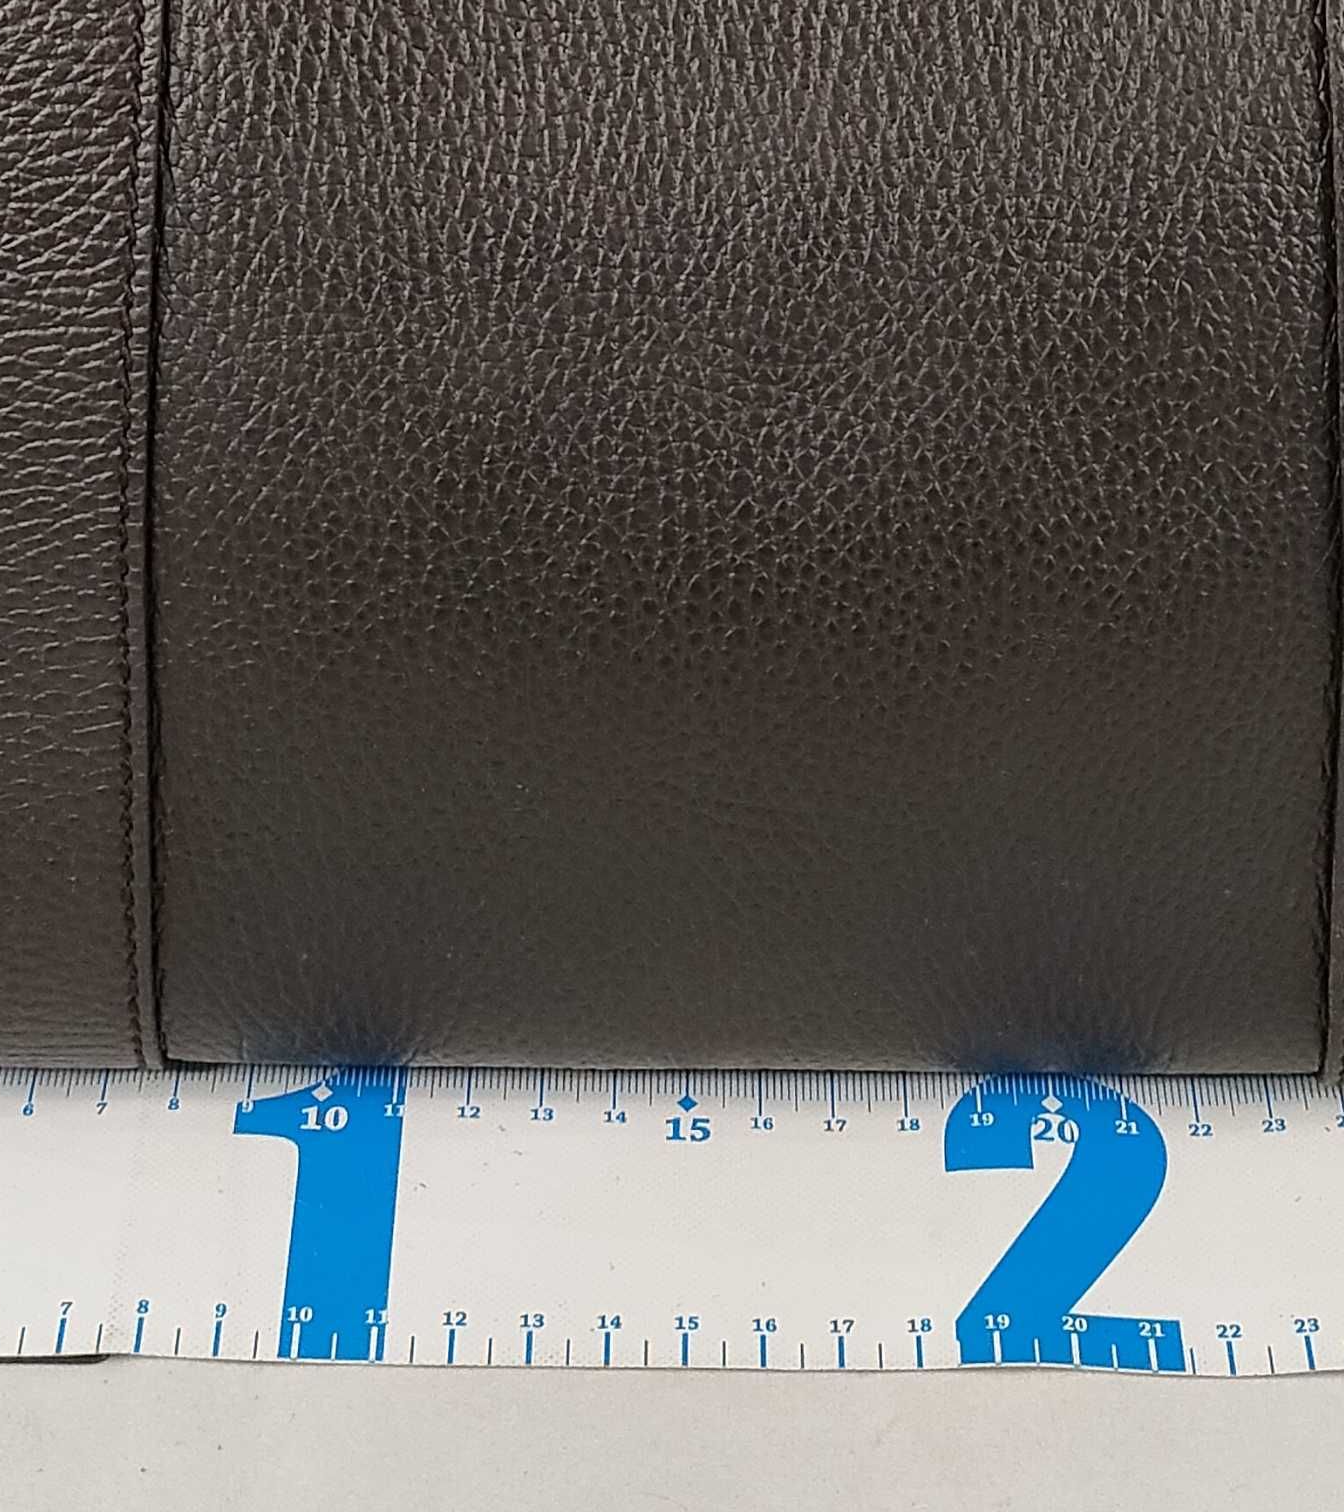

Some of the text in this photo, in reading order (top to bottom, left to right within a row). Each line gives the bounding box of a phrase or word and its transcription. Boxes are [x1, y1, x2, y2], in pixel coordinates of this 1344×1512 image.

[22, 1104, 34, 1116] 6
[95, 1102, 108, 1115] 7
[167, 1097, 180, 1110] 8
[241, 1100, 254, 1113] 9
[299, 1105, 349, 1131] 10
[384, 1104, 406, 1117] 11
[456, 1106, 481, 1119] 12
[530, 1108, 554, 1121] 13
[603, 1111, 626, 1124] 14
[665, 1117, 712, 1143] 15
[750, 1116, 774, 1130] 16
[823, 1118, 848, 1132] 17
[896, 1118, 921, 1131] 18
[969, 1112, 995, 1127] 19
[1032, 1115, 1080, 1143] 20
[1115, 1120, 1140, 1135] 21
[1188, 1124, 1213, 1137] 22
[1262, 1118, 1287, 1133] 23
[233, 1065, 406, 1361] 1
[944, 1071, 1186, 1373] 2
[60, 1302, 73, 1315] 7
[136, 1299, 150, 1314] 8
[215, 1303, 227, 1318] 9
[287, 1306, 313, 1322] 10
[364, 1309, 389, 1324] 11
[442, 1311, 468, 1326] 12
[520, 1314, 545, 1328] 13
[597, 1315, 622, 1329] 14
[674, 1316, 699, 1330] 15
[752, 1318, 778, 1332] 16
[830, 1320, 855, 1333] 17
[907, 1319, 932, 1333] 18
[984, 1314, 1010, 1329] 19
[1062, 1315, 1087, 1332] 20
[1138, 1322, 1165, 1337] 21
[1216, 1324, 1242, 1338] 22
[1294, 1318, 1320, 1333] 23
